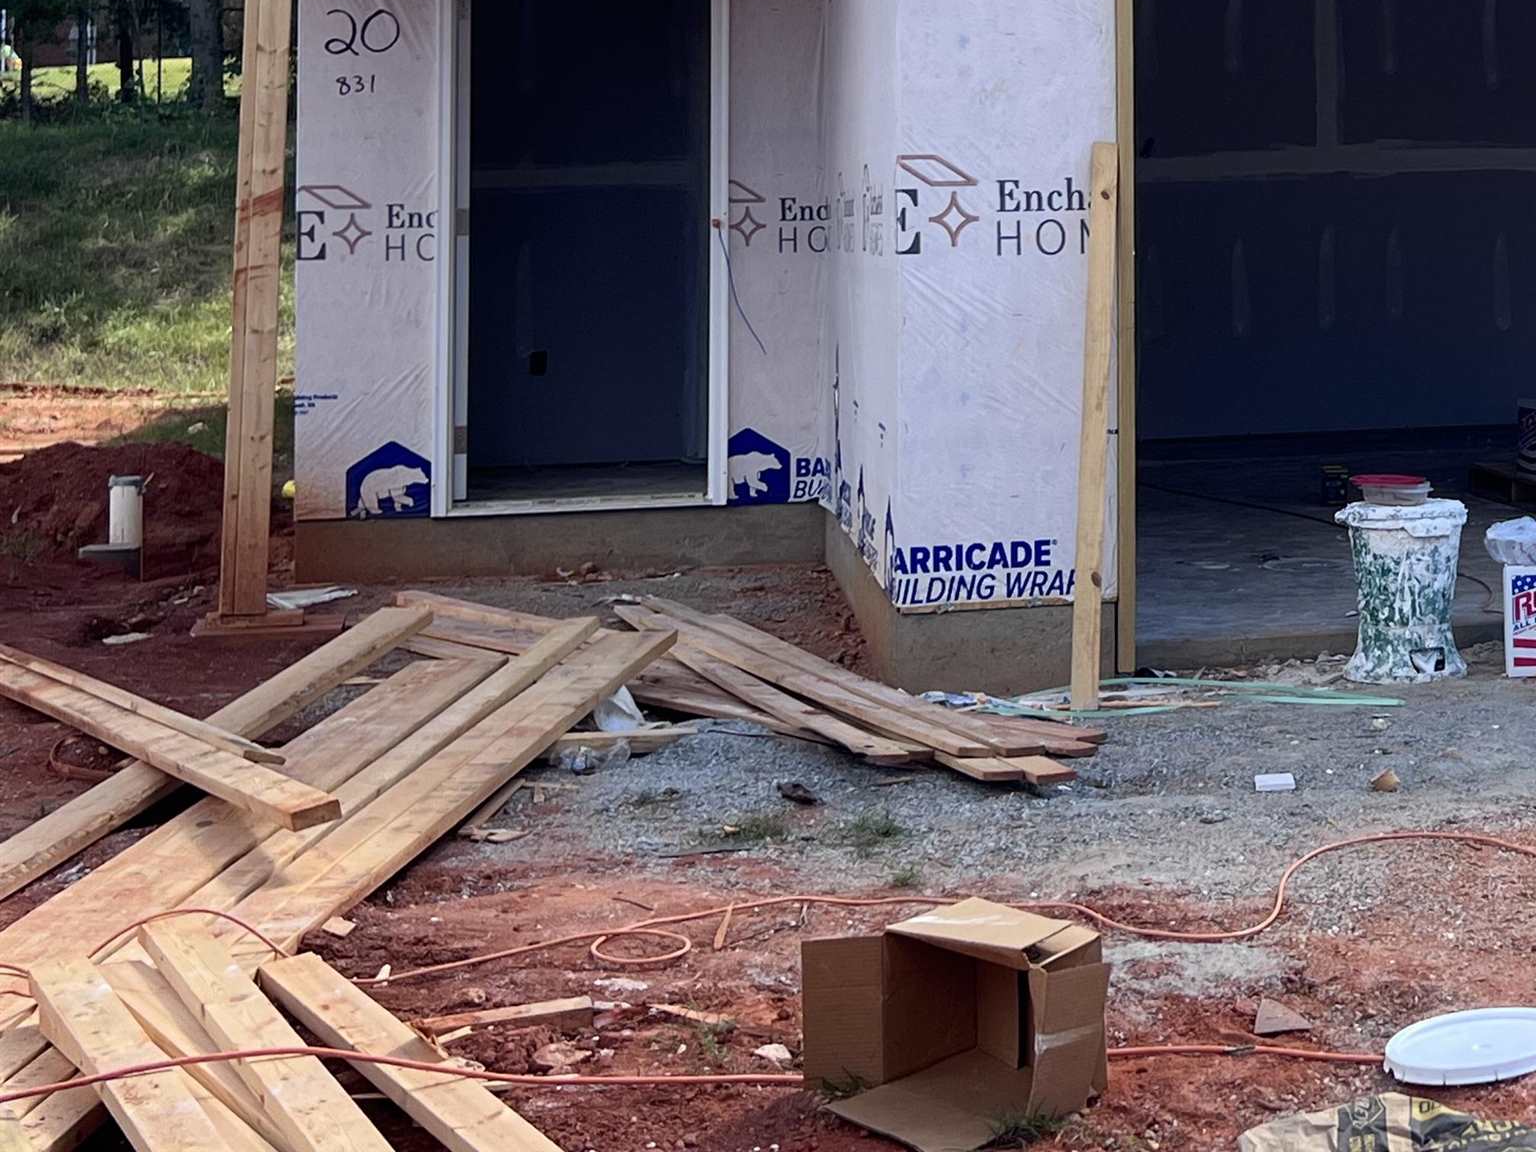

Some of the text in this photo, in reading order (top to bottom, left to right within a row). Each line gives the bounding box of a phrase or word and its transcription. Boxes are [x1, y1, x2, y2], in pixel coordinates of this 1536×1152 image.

[324, 9, 400, 56] 20
[336, 74, 375, 95] 831
[894, 540, 1051, 575] ARRICADE
[1513, 619, 1531, 632] ALL
